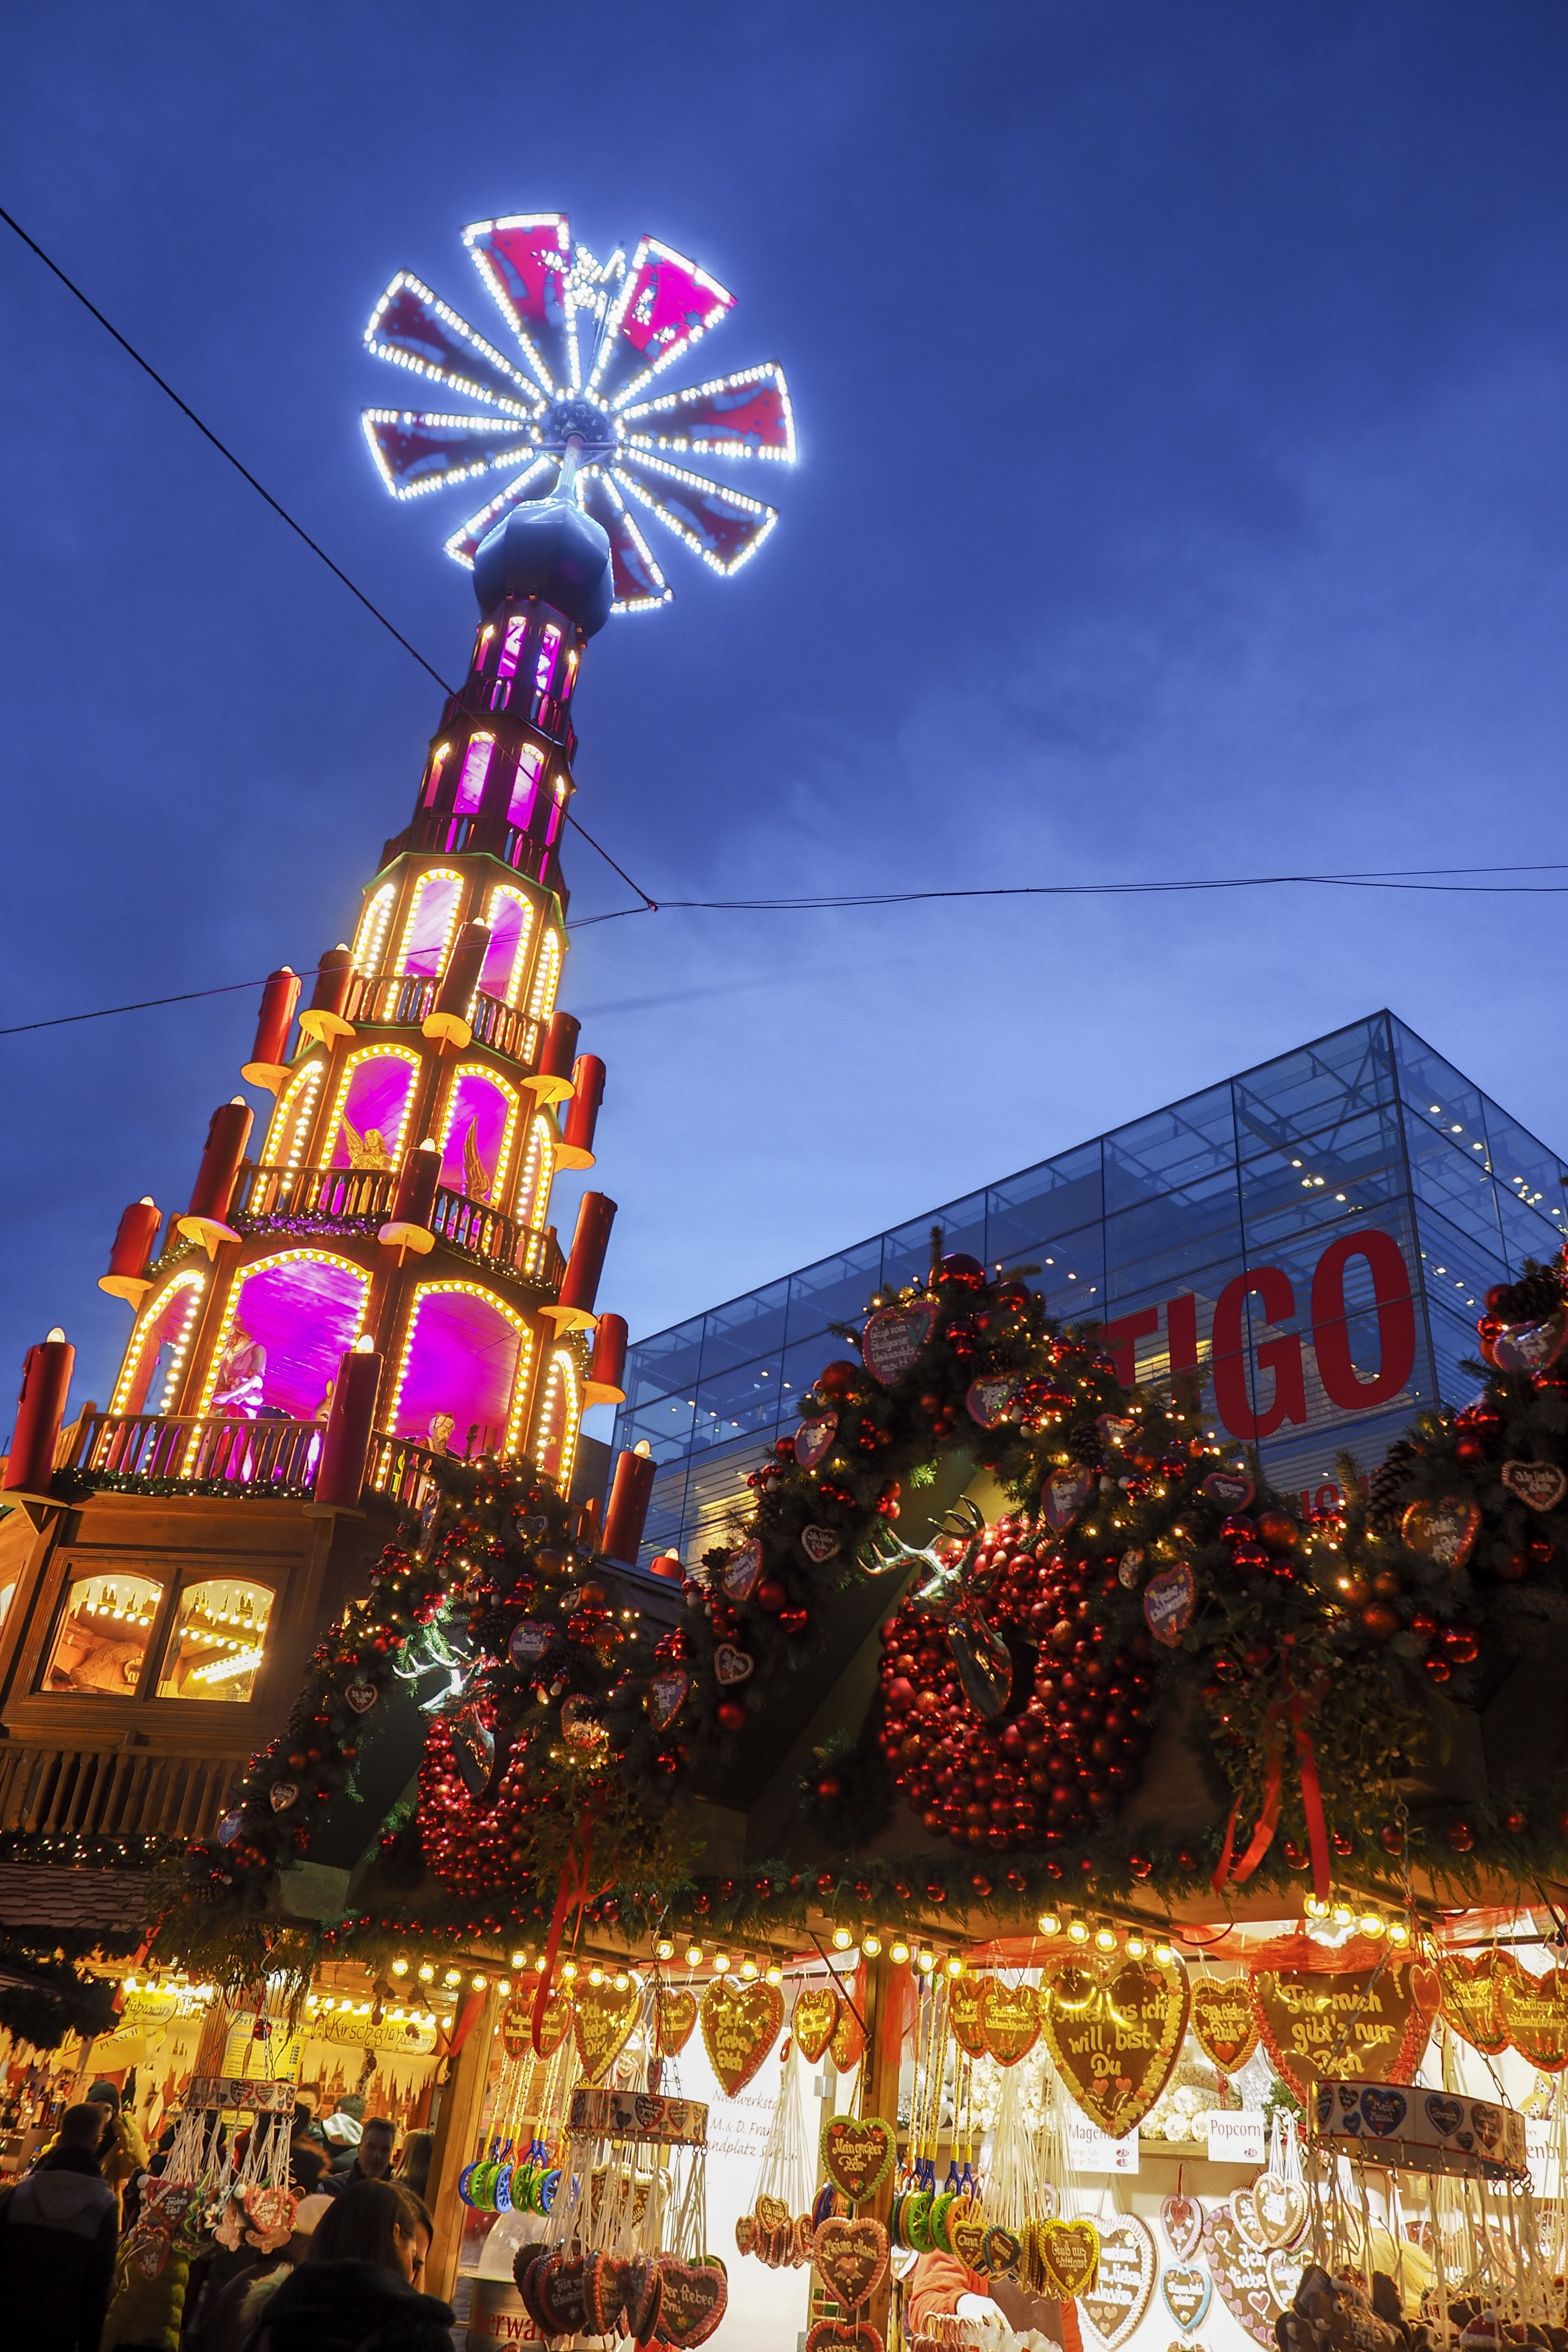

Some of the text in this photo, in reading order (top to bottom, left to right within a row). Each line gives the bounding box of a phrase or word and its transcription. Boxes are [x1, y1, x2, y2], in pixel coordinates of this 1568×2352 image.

[890, 1325, 907, 1334] vom
[1141, 1994, 1167, 2020] ich
[1281, 1984, 1383, 2014] Für mich
[100, 2027, 138, 2051] PUNSCH
[1068, 2023, 1152, 2054] will, bist
[1210, 2021, 1240, 2042] Dich
[1291, 2014, 1396, 2054] gibt's nur
[717, 2050, 743, 2072] Dich
[1090, 2053, 1122, 2078] Du
[1313, 2044, 1365, 2075] Dich
[1372, 2100, 1395, 2112] Mein
[736, 2120, 745, 2134] D.
[1211, 2120, 1261, 2140] Popcorn
[164, 2205, 181, 2214] Fest
[165, 2196, 187, 2206] Frohes
[259, 2201, 279, 2212] Frohes
[260, 2211, 274, 2221] Fest
[958, 2234, 978, 2247] Oma
[1051, 2239, 1087, 2258] Gruß aus
[1238, 2243, 1267, 2268] Ich
[662, 2300, 683, 2315] Omi
